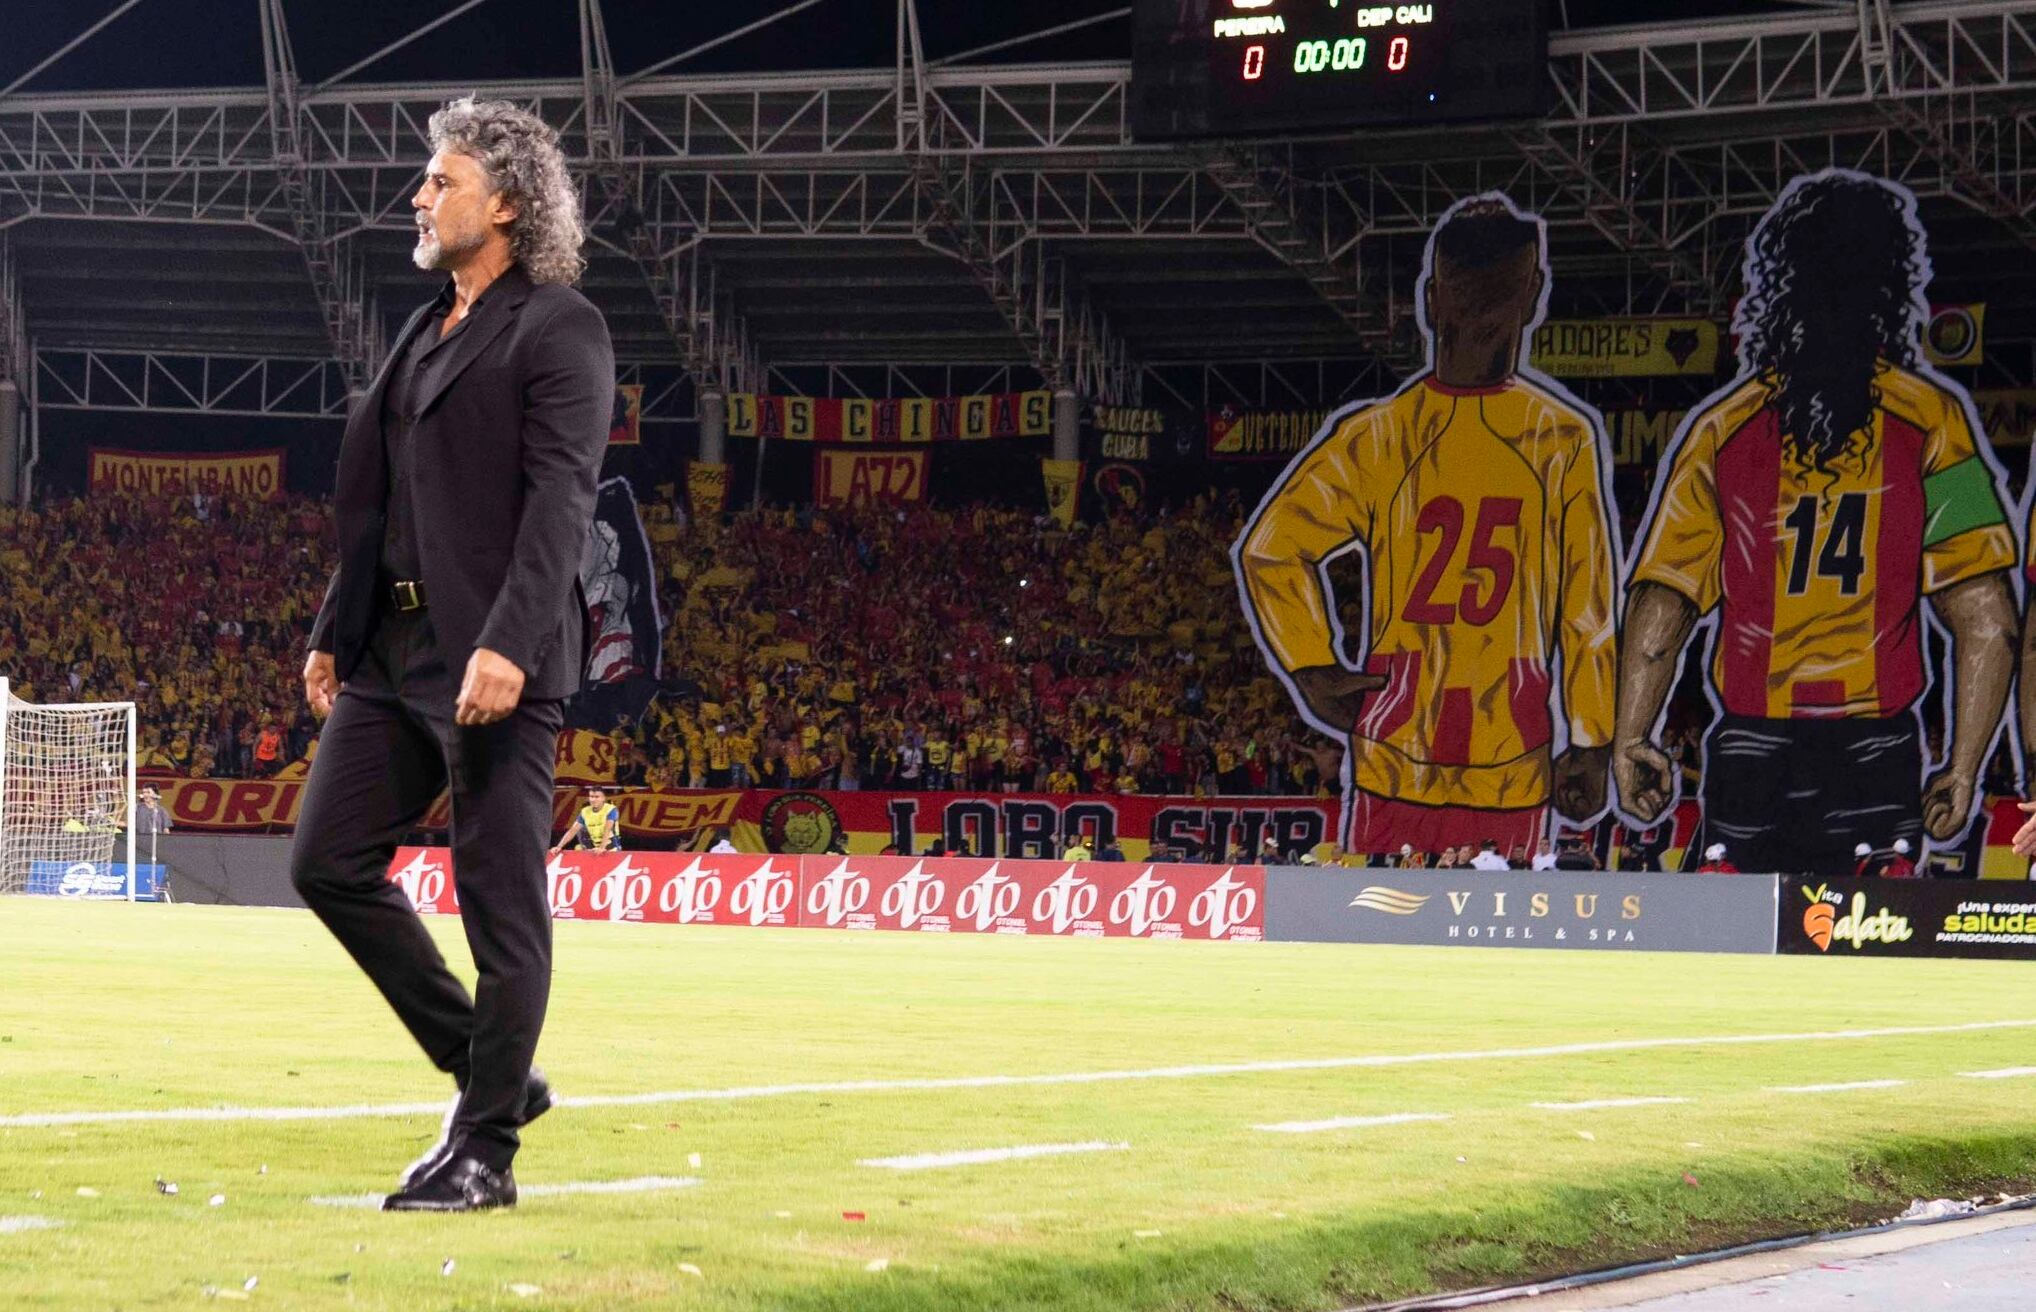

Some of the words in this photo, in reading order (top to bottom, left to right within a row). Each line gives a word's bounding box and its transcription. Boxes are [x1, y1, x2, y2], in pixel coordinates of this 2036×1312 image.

[1214, 16, 1286, 38] PEREIRA
[1358, 9, 1393, 27] DEP
[1396, 4, 1433, 24] CALI
[1244, 46, 1264, 80] 0
[1295, 38, 1366, 72] 00:00
[1388, 37, 1408, 71] 0
[1534, 324, 1652, 360] ADORES
[732, 397, 811, 437] LAS
[848, 396, 1046, 441] CHINGAS
[1401, 494, 1524, 627] 25
[1784, 490, 1869, 598] 14
[888, 799, 1119, 862] LOBO
[1155, 806, 1327, 865] SUR
[802, 857, 870, 927] oto
[881, 859, 946, 929] oto
[956, 861, 1021, 932] oto
[1032, 863, 1098, 934] oto
[1109, 865, 1177, 937] oto
[1188, 866, 1257, 939] oto
[1446, 891, 1642, 920] VISUS
[1448, 926, 1534, 940] HOTEL
[1555, 927, 1567, 940] &
[1589, 928, 1635, 942] SPA
